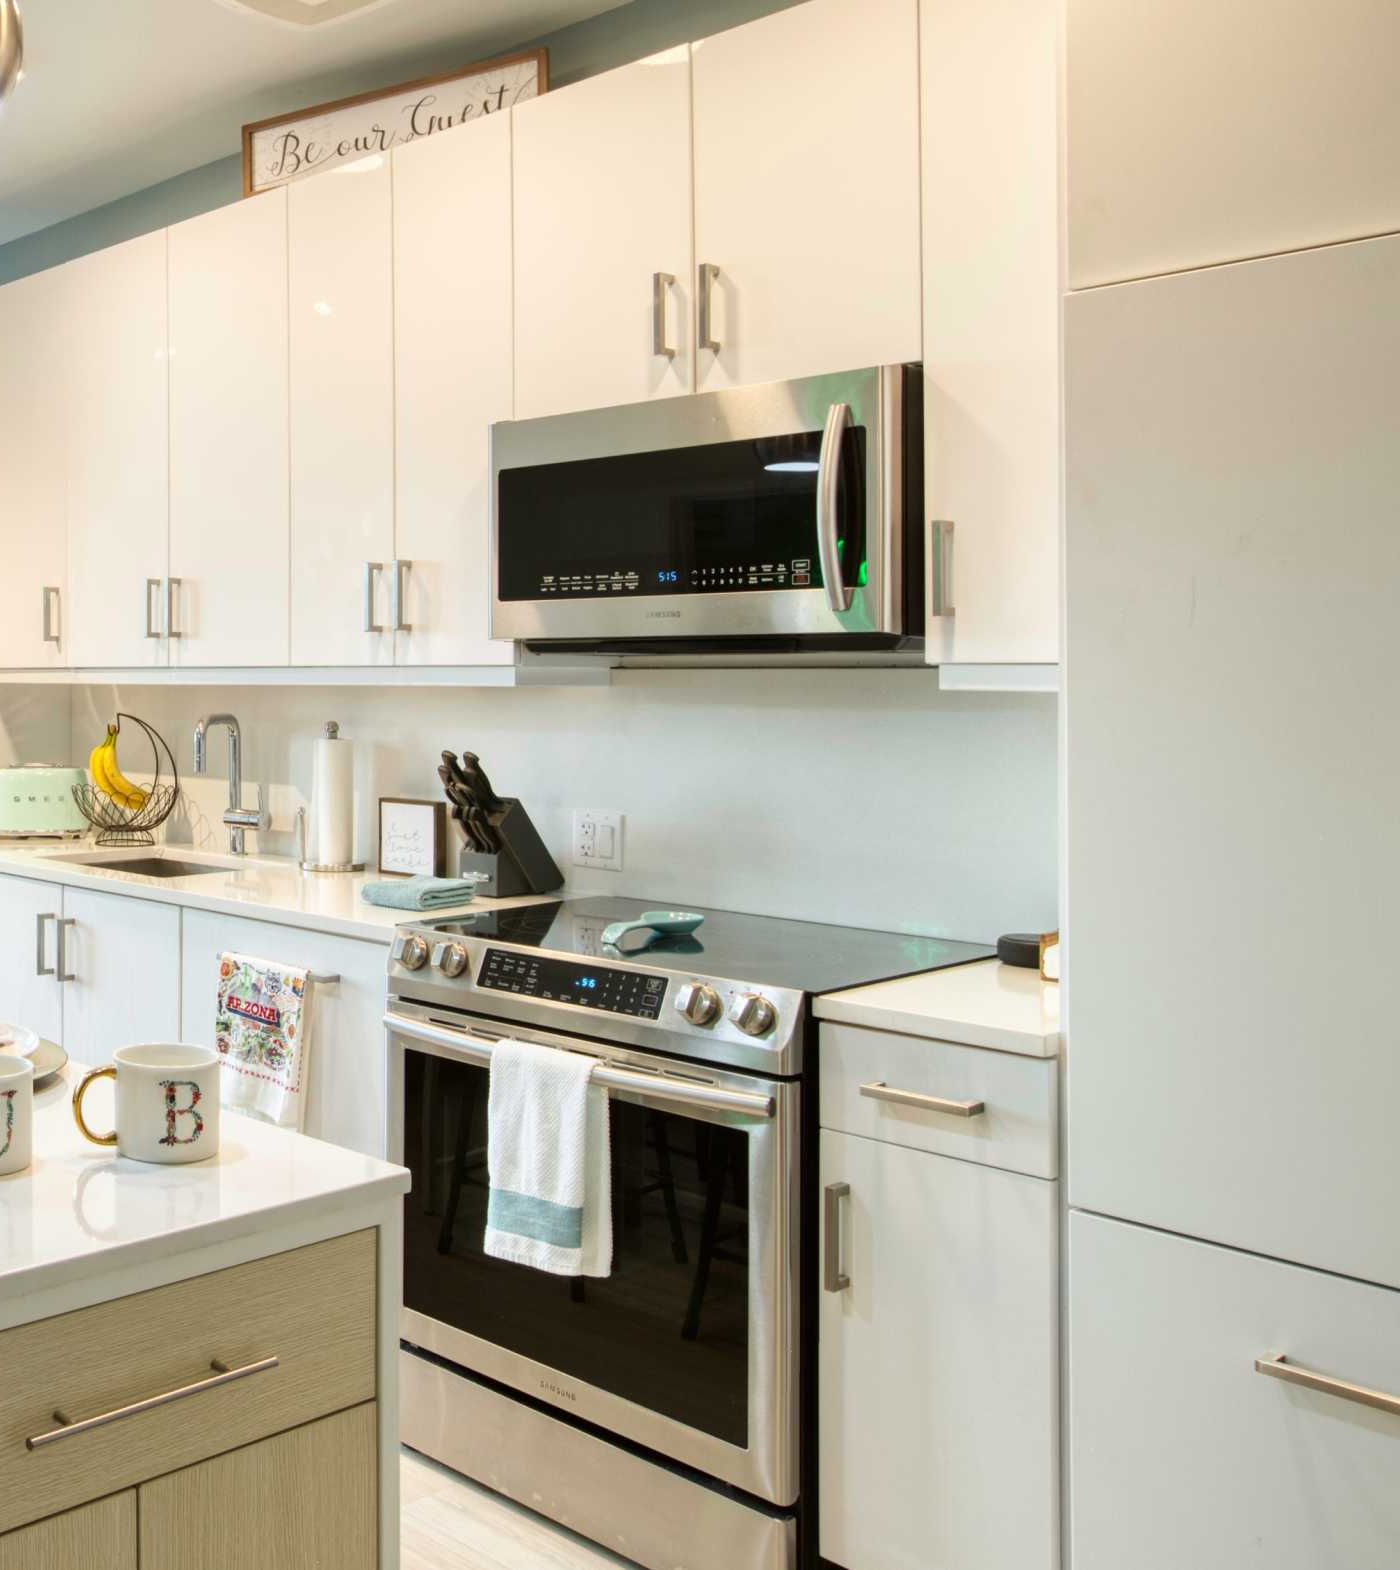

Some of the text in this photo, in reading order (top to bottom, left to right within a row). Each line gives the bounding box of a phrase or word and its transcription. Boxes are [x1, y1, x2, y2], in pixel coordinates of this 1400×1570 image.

[266, 83, 511, 177] Be our Guest
[227, 996, 276, 1021] ARZONA
[158, 1080, 204, 1146] B
